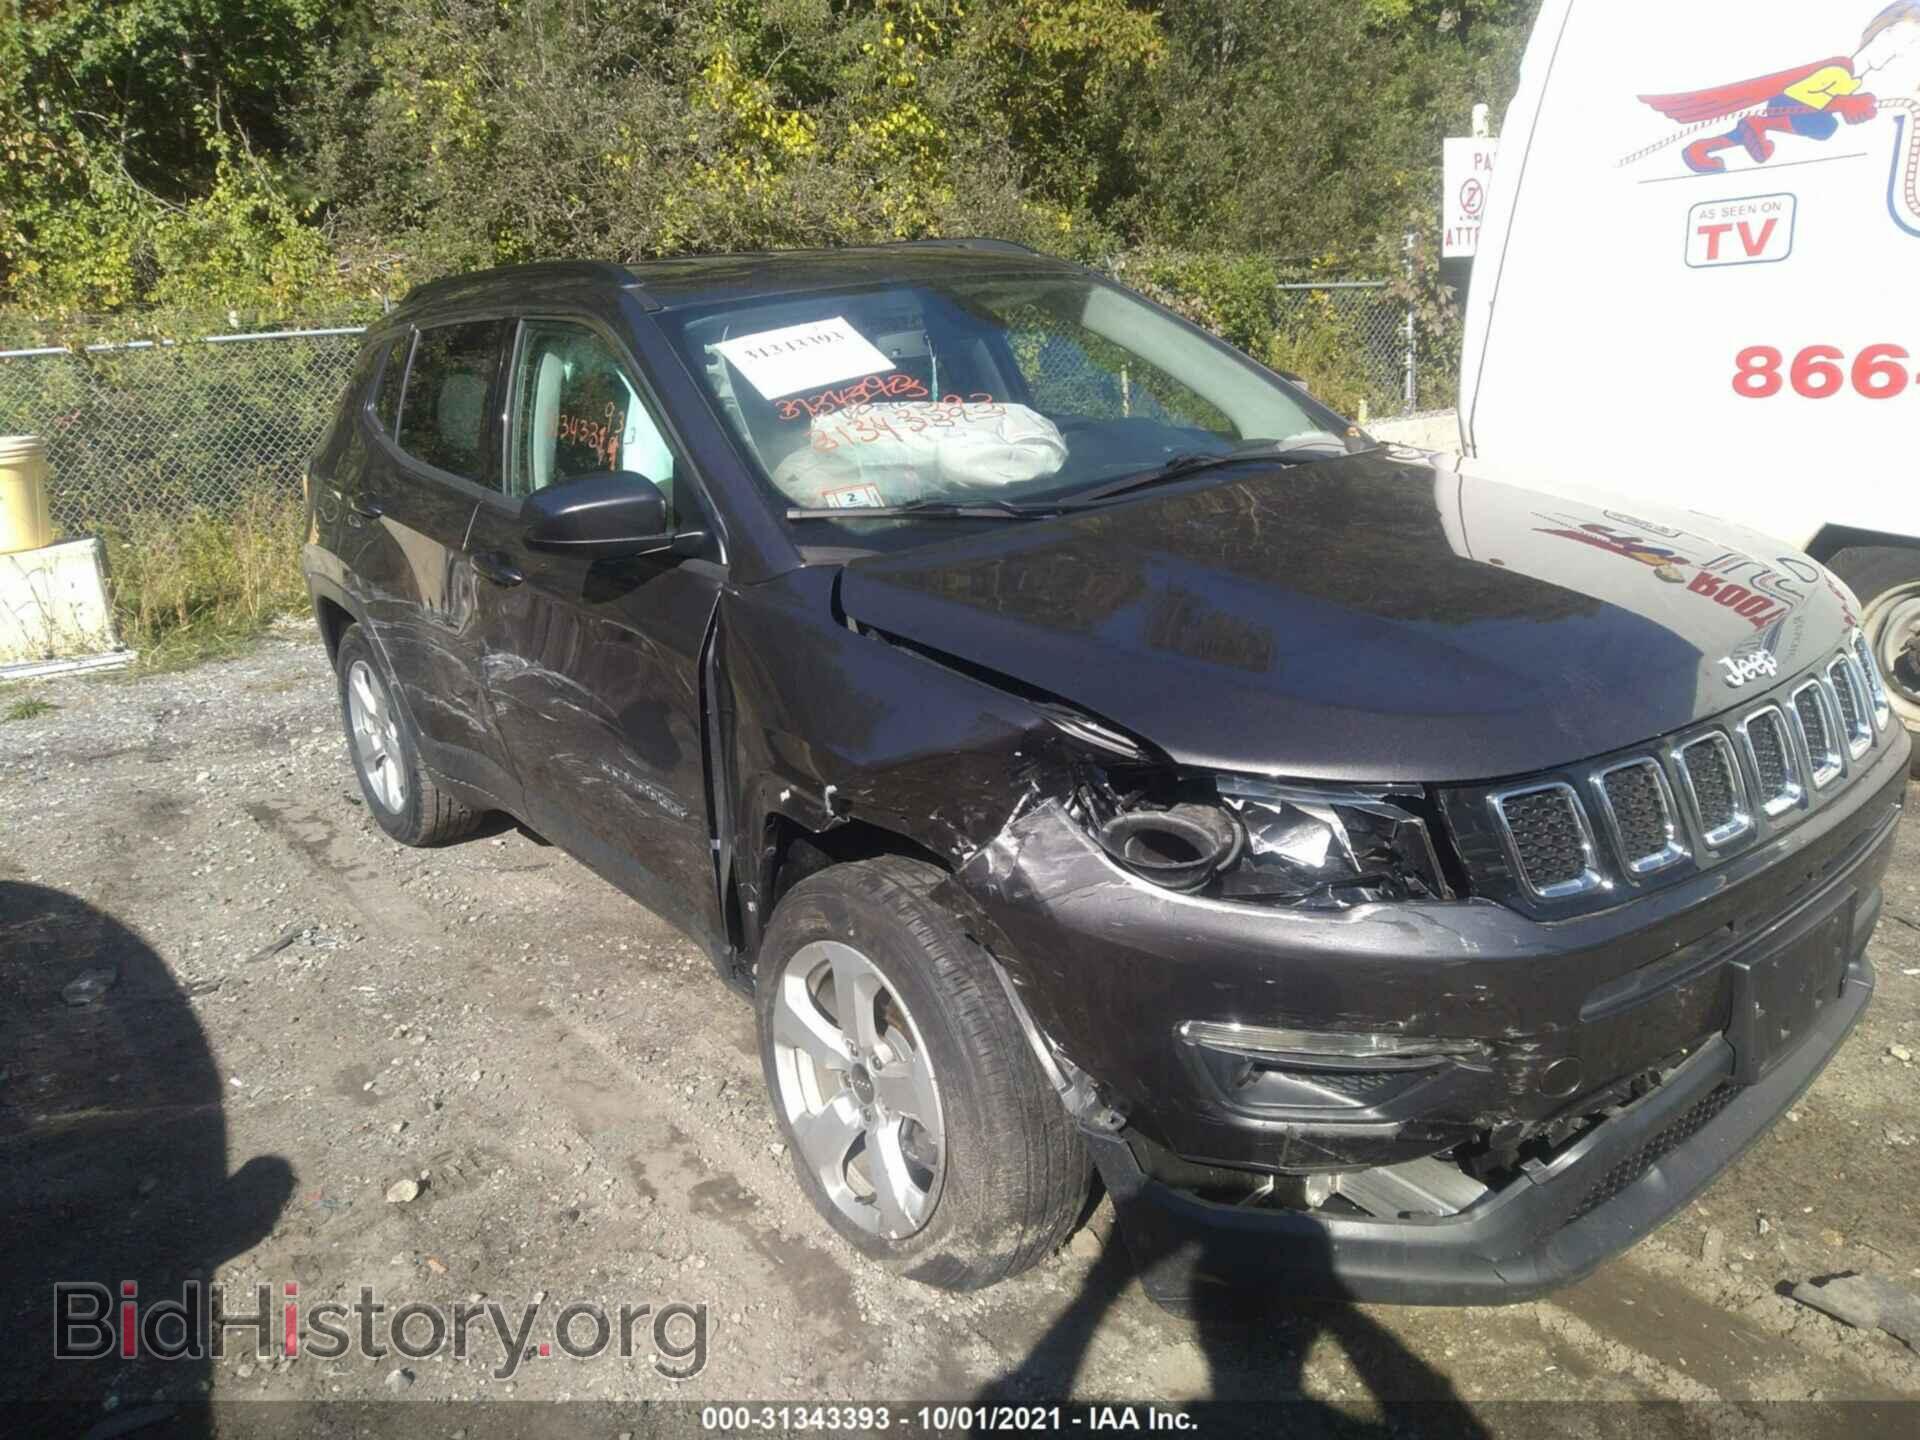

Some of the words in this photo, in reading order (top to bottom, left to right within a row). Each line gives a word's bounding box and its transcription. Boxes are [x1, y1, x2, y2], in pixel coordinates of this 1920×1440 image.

[1699, 208, 1716, 220] AS
[1721, 204, 1757, 218] SEEN
[1761, 201, 1782, 214] ON
[1697, 218, 1779, 261] TV
[847, 493, 858, 503] 2
[1717, 649, 1778, 687] Jeep
